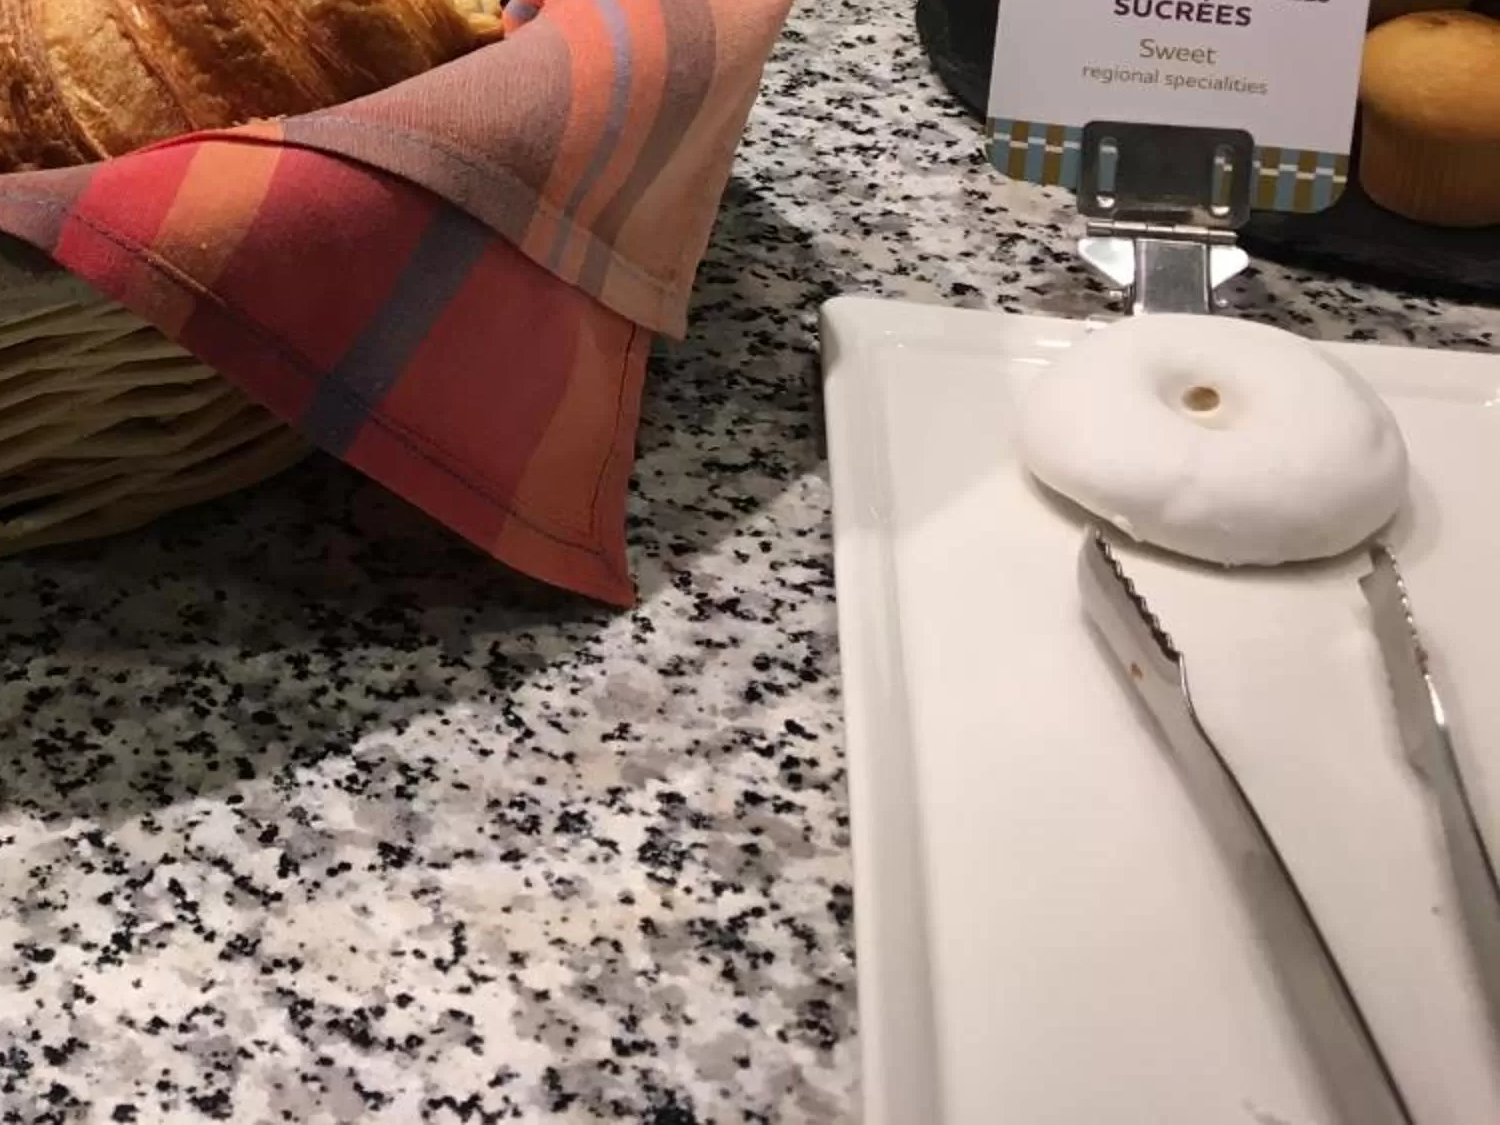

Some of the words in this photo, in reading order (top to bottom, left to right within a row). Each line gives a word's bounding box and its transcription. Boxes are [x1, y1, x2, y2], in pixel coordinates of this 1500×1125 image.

[1139, 38, 1217, 64] Sweet
[1082, 65, 1160, 84] regional
[1164, 71, 1269, 95] specialities
